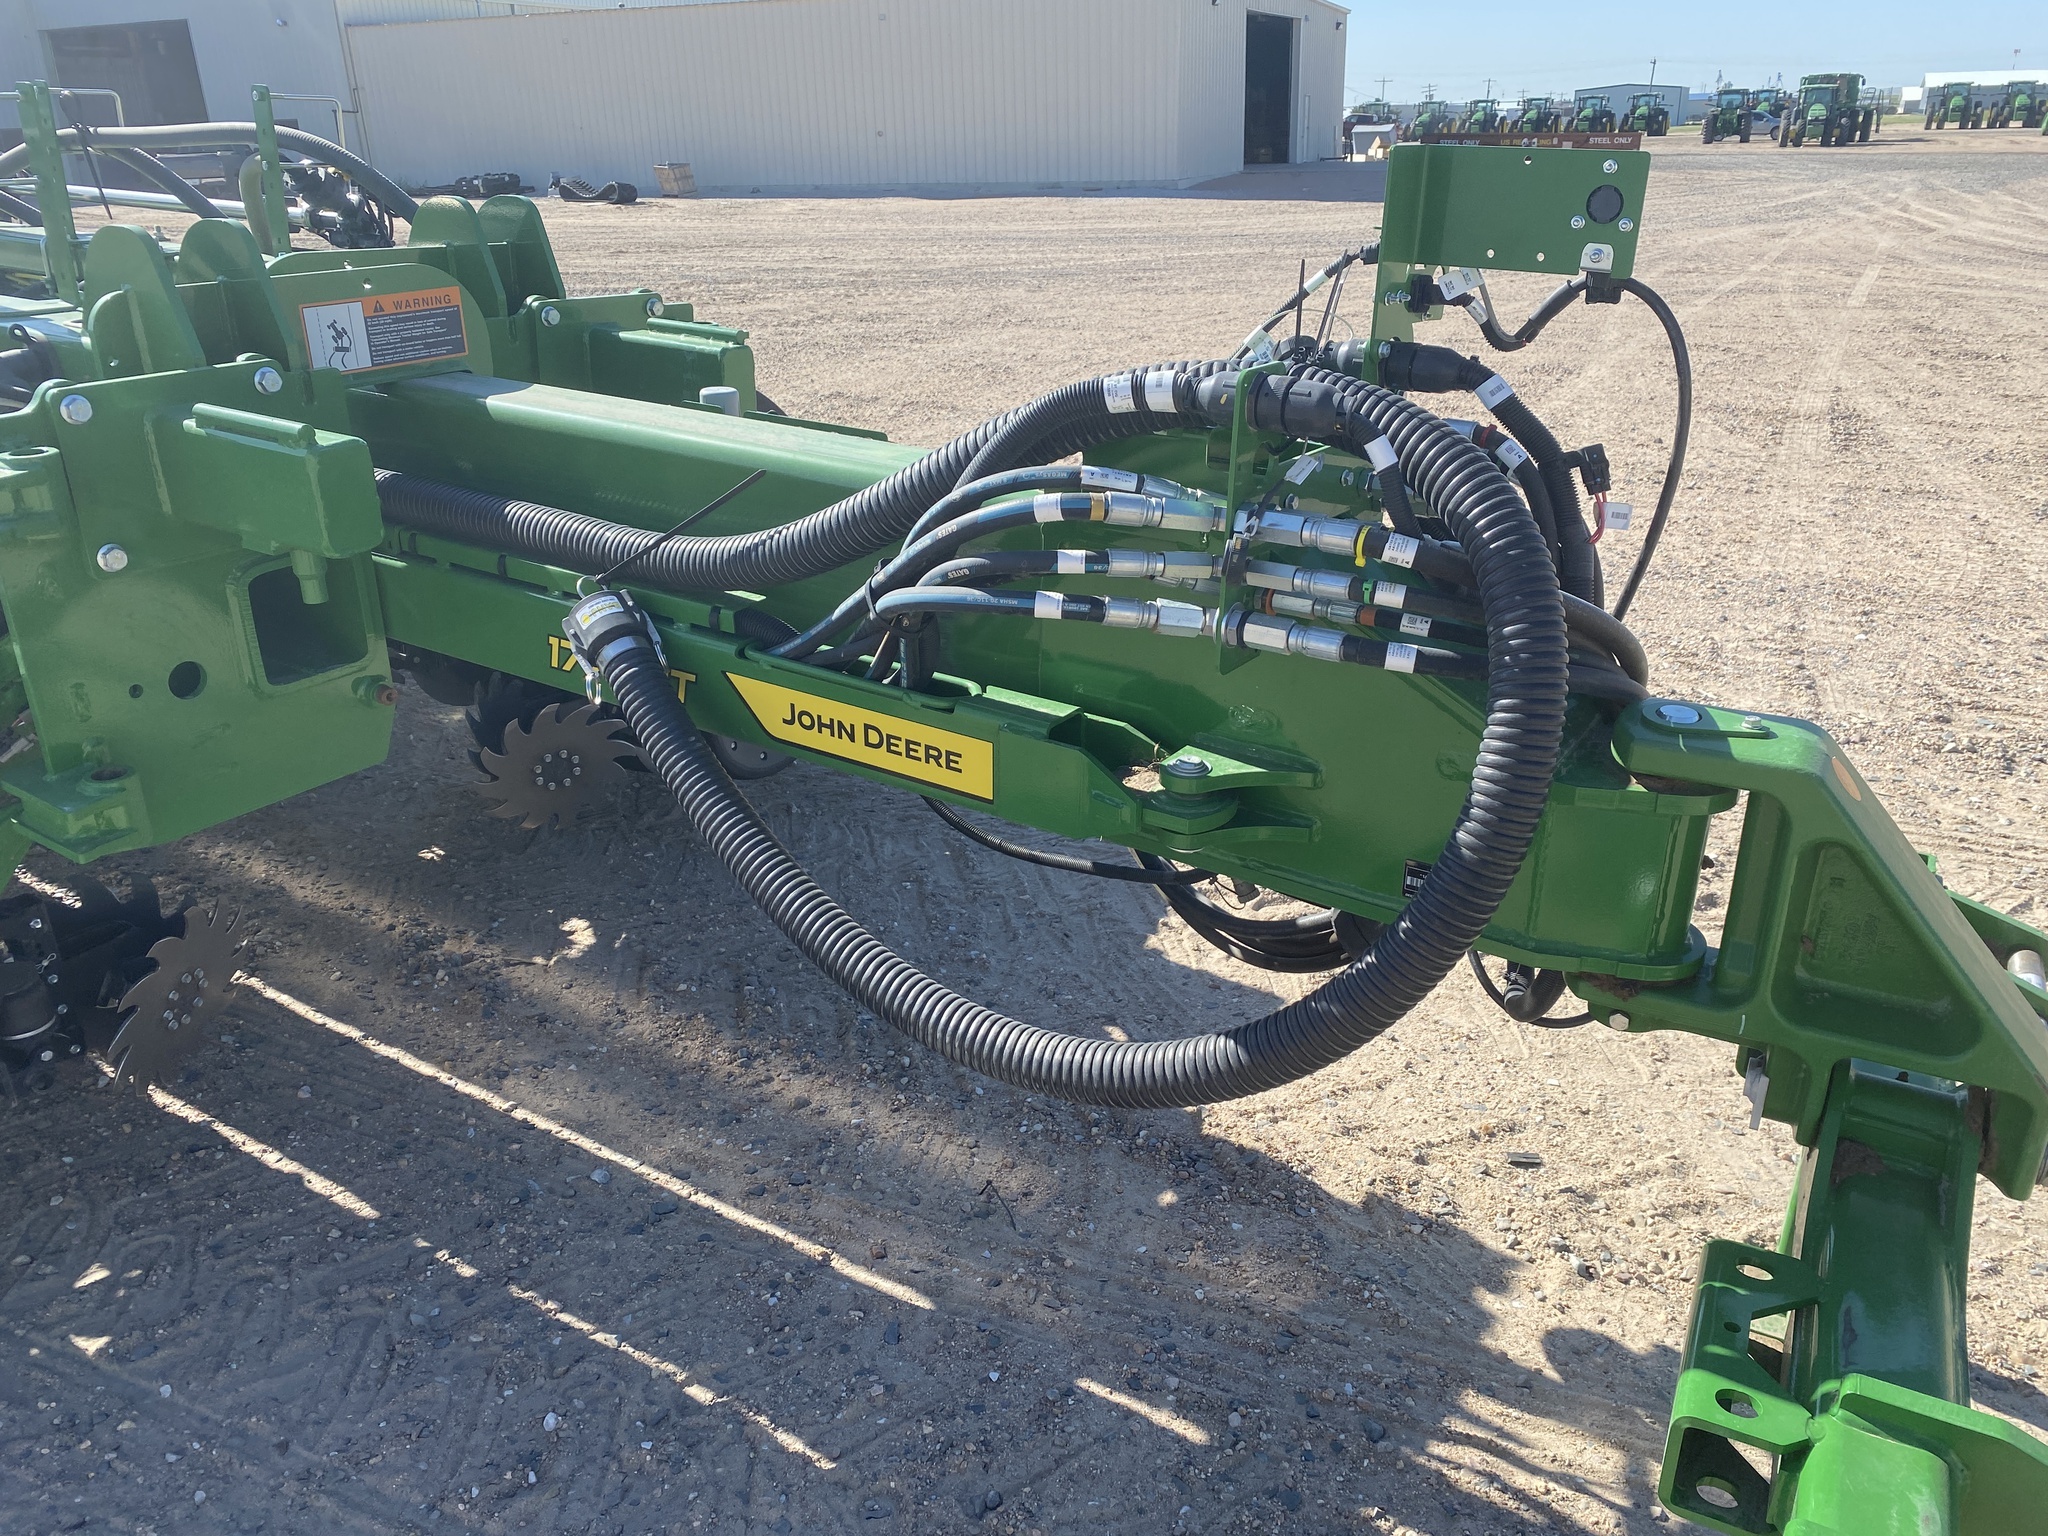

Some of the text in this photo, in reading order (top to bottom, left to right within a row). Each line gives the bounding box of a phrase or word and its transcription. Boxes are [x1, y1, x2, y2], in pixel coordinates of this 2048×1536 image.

[392, 294, 452, 310] WARNING
[936, 524, 957, 540] GATES
[948, 568, 970, 579] GATES
[782, 702, 963, 774] JOHN DEERE
